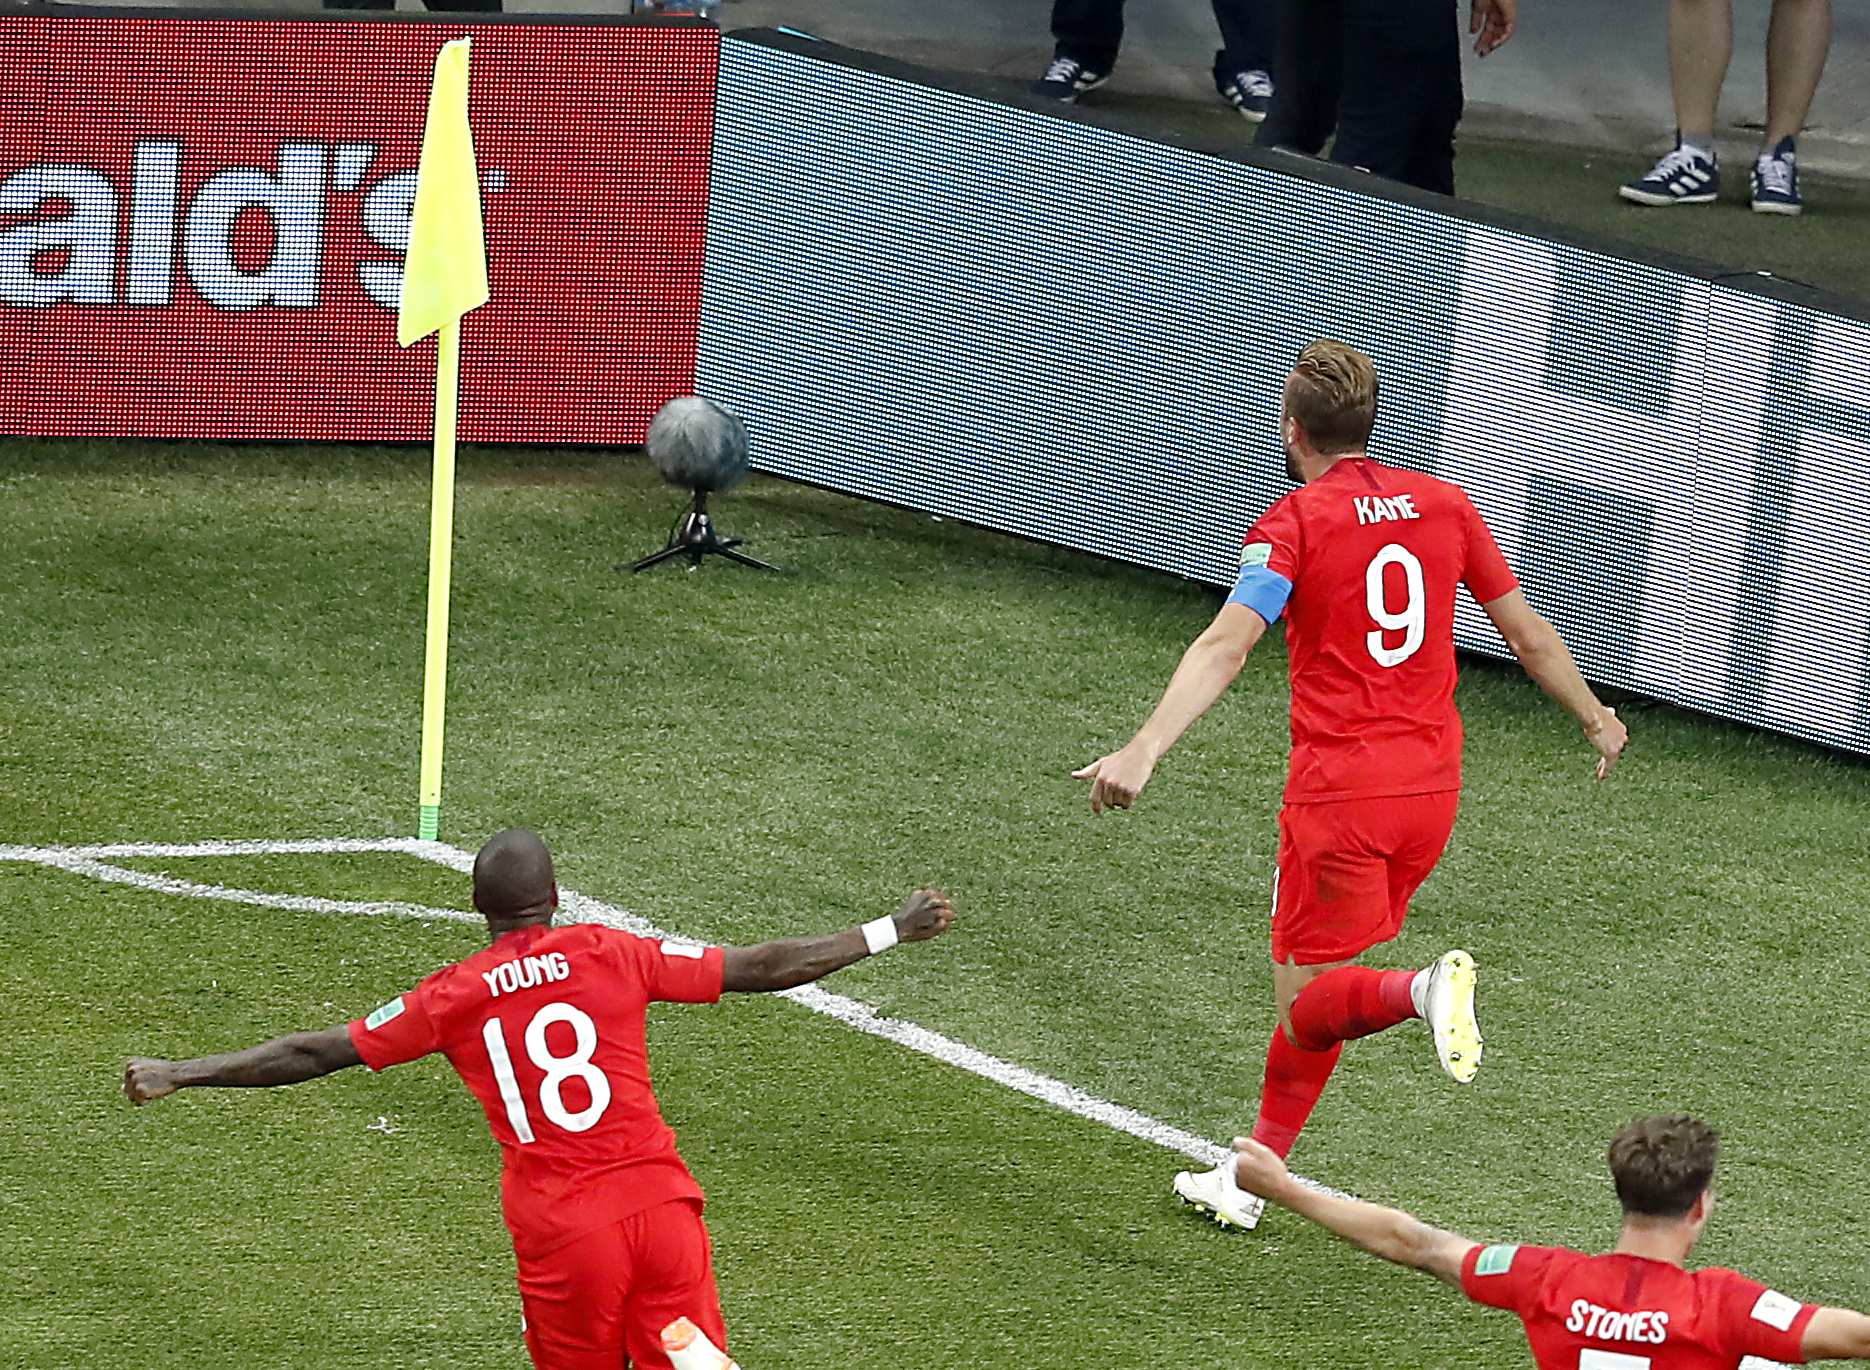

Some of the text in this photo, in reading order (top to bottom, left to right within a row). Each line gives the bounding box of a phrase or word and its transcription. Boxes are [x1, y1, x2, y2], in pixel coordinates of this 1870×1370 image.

[1353, 494, 1421, 525] KANE
[1365, 543, 1426, 667] 9
[482, 952, 570, 997] YOUNG
[482, 1002, 612, 1143] 18
[1566, 1299, 1670, 1344] STONES
